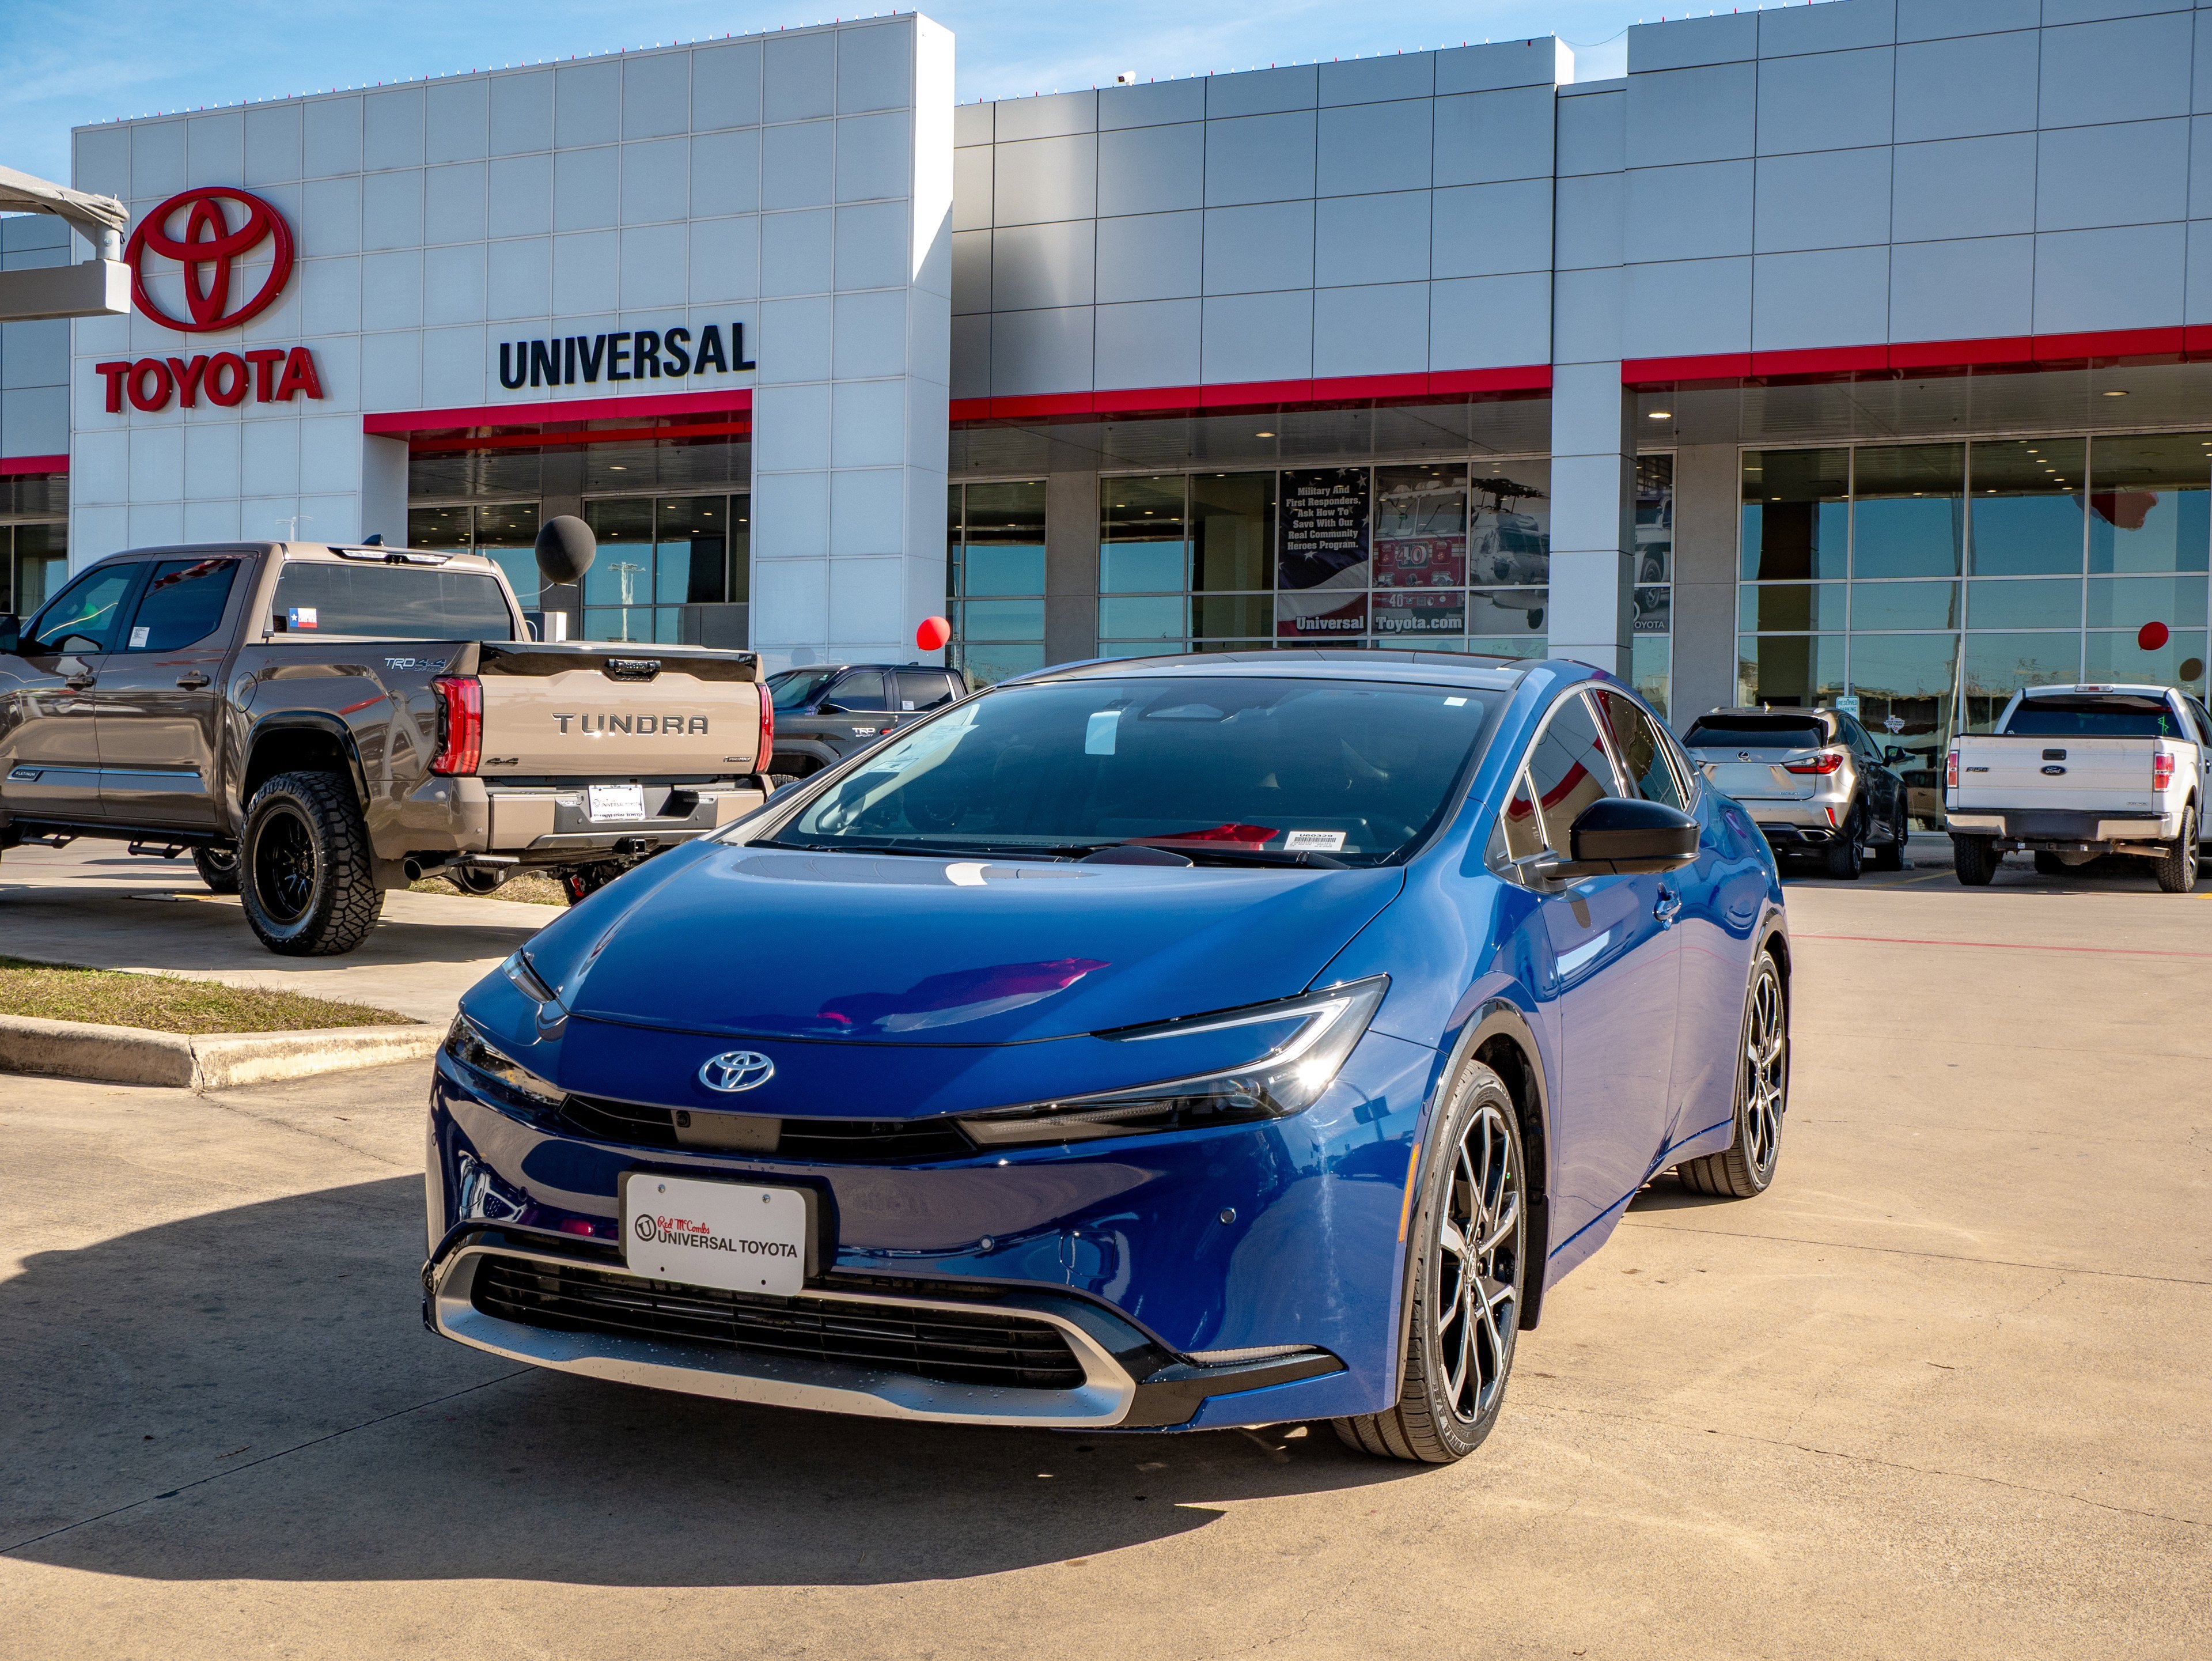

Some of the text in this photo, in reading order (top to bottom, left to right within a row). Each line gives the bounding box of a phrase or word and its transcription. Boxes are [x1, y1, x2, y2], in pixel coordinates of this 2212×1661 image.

[499, 322, 756, 390] UNIVERSAL
[95, 346, 324, 414] TOYOTA
[1297, 485, 1350, 497] Military And
[1286, 496, 1361, 507] First Responders,
[1297, 507, 1349, 517] Ask How To
[1293, 518, 1354, 528] Save With Our
[1288, 528, 1359, 539] Real Community
[1287, 540, 1358, 551] Heroes Program.
[1396, 545, 1427, 565] 40
[1389, 594, 1403, 607] 40
[1296, 615, 1463, 633] Universal Toyota.com
[1634, 620, 1665, 629] OYOTA
[384, 657, 415, 669] TRD
[552, 713, 709, 736] TUNDRA
[657, 1216, 710, 1234] Red McCombs
[658, 1230, 798, 1258] UNIVERSAL TOYOTA
